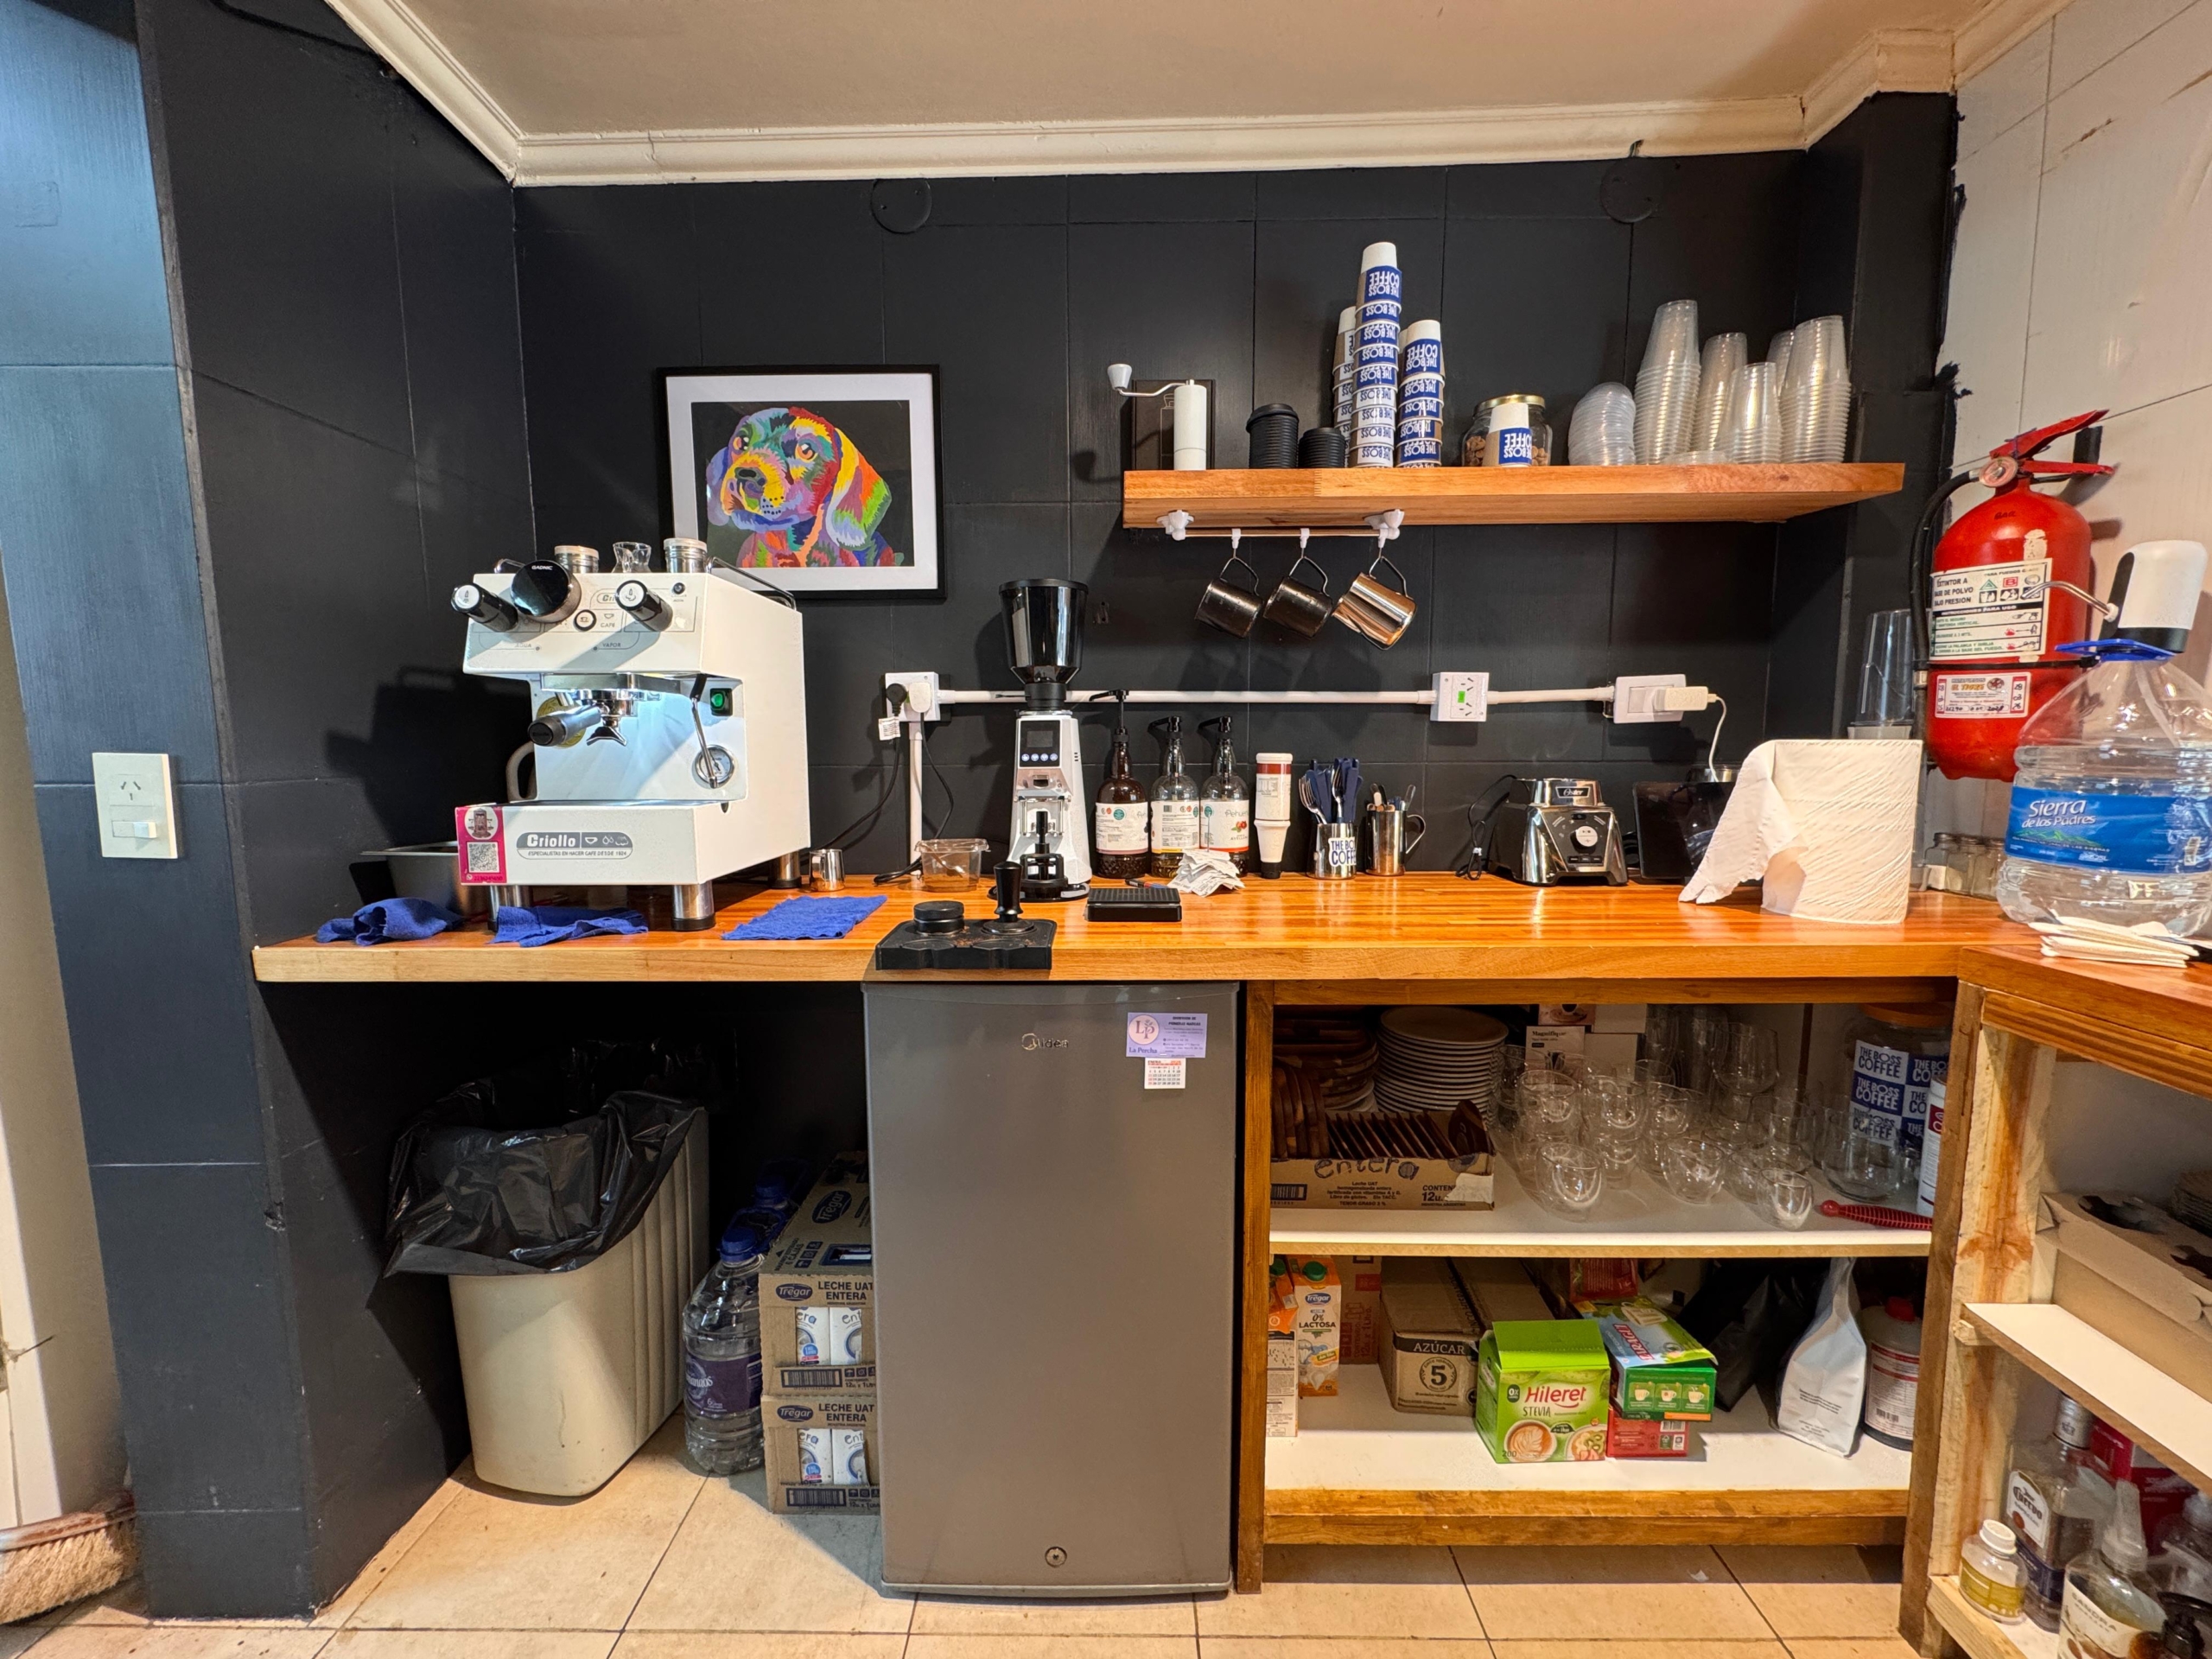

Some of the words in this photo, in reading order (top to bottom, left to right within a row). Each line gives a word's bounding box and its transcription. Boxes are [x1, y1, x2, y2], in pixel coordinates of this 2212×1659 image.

[1369, 271, 1400, 288] COFFEE
[1368, 284, 1389, 296] BOSS
[1391, 286, 1399, 298] THE
[1365, 304, 1388, 316] BOSS
[1388, 305, 1397, 318] THE
[1363, 327, 1385, 340] BOSS
[1386, 325, 1395, 338] THE
[1362, 347, 1383, 361] BOSS
[1384, 346, 1394, 359] THE
[1407, 344, 1438, 360] COFFEE
[1406, 358, 1427, 372] BOSS
[1427, 356, 1437, 368] THE
[1360, 368, 1382, 382] BOSS
[1382, 368, 1392, 381] THE
[1405, 382, 1424, 397] BOSS
[1425, 380, 1436, 394] THE
[1382, 388, 1391, 400] THE
[1383, 408, 1393, 420] THE
[1361, 428, 1382, 439] BOSS
[1382, 427, 1392, 439] THE
[1504, 433, 1532, 448] OFFEE
[1362, 446, 1382, 458] BOSS
[1404, 442, 1424, 456] BOSS
[1425, 441, 1436, 454] THE
[2030, 800, 2088, 817] Sierra
[2022, 819, 2032, 828] de
[2032, 817, 2051, 828] los
[2055, 815, 2096, 826] Padres
[527, 834, 576, 848] Criollo
[1331, 840, 1343, 849] THE
[1345, 839, 1355, 850] BO
[1332, 850, 1357, 864] COFFE
[1859, 1046, 1872, 1058] THE
[1873, 1051, 1901, 1065] BOSS
[1859, 1056, 1899, 1078] COFFEE
[1915, 1059, 1930, 1070] THE
[1930, 1061, 1947, 1071] BO
[1858, 1077, 1870, 1088] THE
[1872, 1082, 1899, 1097] BOSS
[1856, 1086, 1897, 1110] COFFEE
[1911, 1090, 1926, 1101] THE
[1853, 1117, 1892, 1139] COFFEE
[1908, 1122, 1923, 1134] THE
[1422, 1192, 1443, 1201] 12u.
[816, 1192, 845, 1220] Tregar
[779, 1287, 810, 1296] Tregar
[817, 1281, 852, 1290] LECHE
[826, 1291, 867, 1300] ENTERA
[797, 1312, 817, 1324] era
[842, 1310, 861, 1324] ent
[1414, 1341, 1465, 1354] AZÚCAR
[1431, 1365, 1447, 1386] 5
[1524, 1386, 1586, 1403] Hileret
[780, 1408, 810, 1419] Tregar
[819, 1403, 852, 1412] LECHE
[1522, 1407, 1550, 1417] STEVIA
[826, 1414, 867, 1422] ENTERA
[798, 1433, 819, 1445] era
[845, 1433, 864, 1445] ent
[2013, 1486, 2043, 1519] Cuervo
[2072, 1592, 2117, 1631] SANDRA
